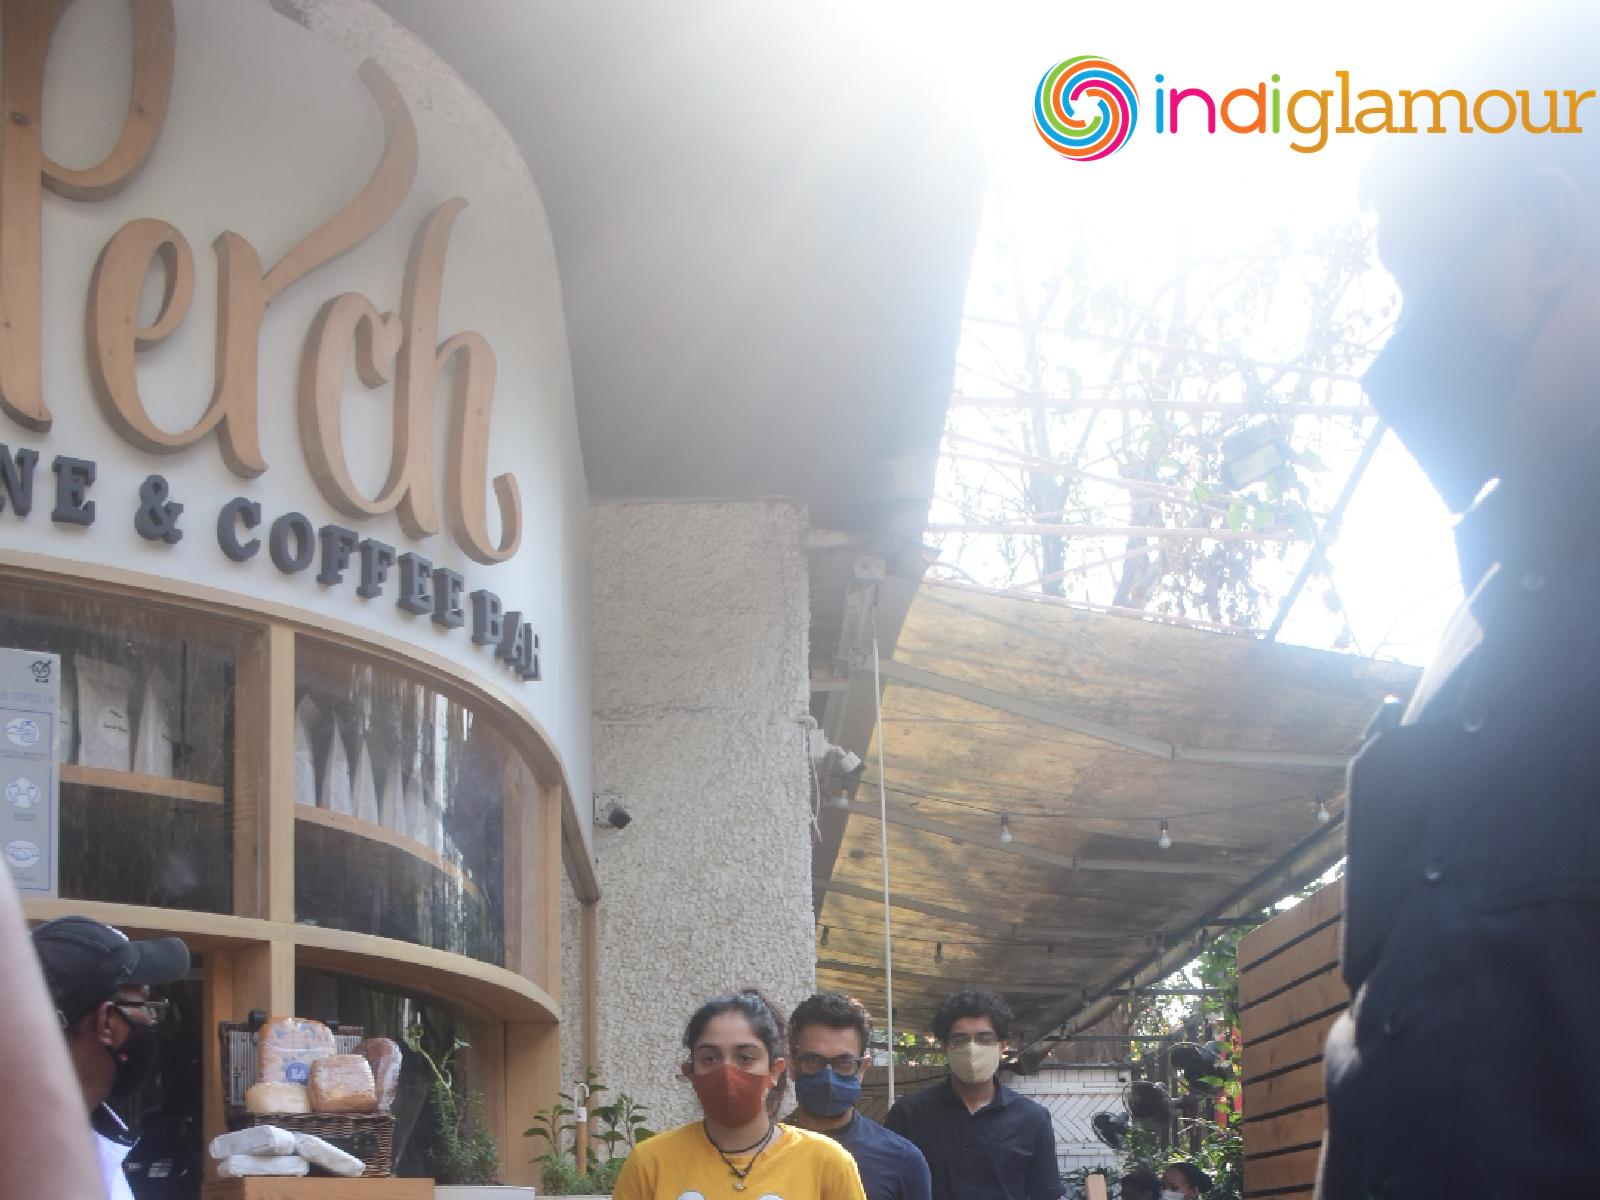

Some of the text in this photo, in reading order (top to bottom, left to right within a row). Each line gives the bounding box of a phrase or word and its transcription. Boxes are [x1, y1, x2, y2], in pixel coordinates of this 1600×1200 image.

[0, 0, 522, 565] Perch
[135, 474, 184, 544] &
[217, 496, 465, 630] COFFEE
[469, 589, 542, 682] BAR
